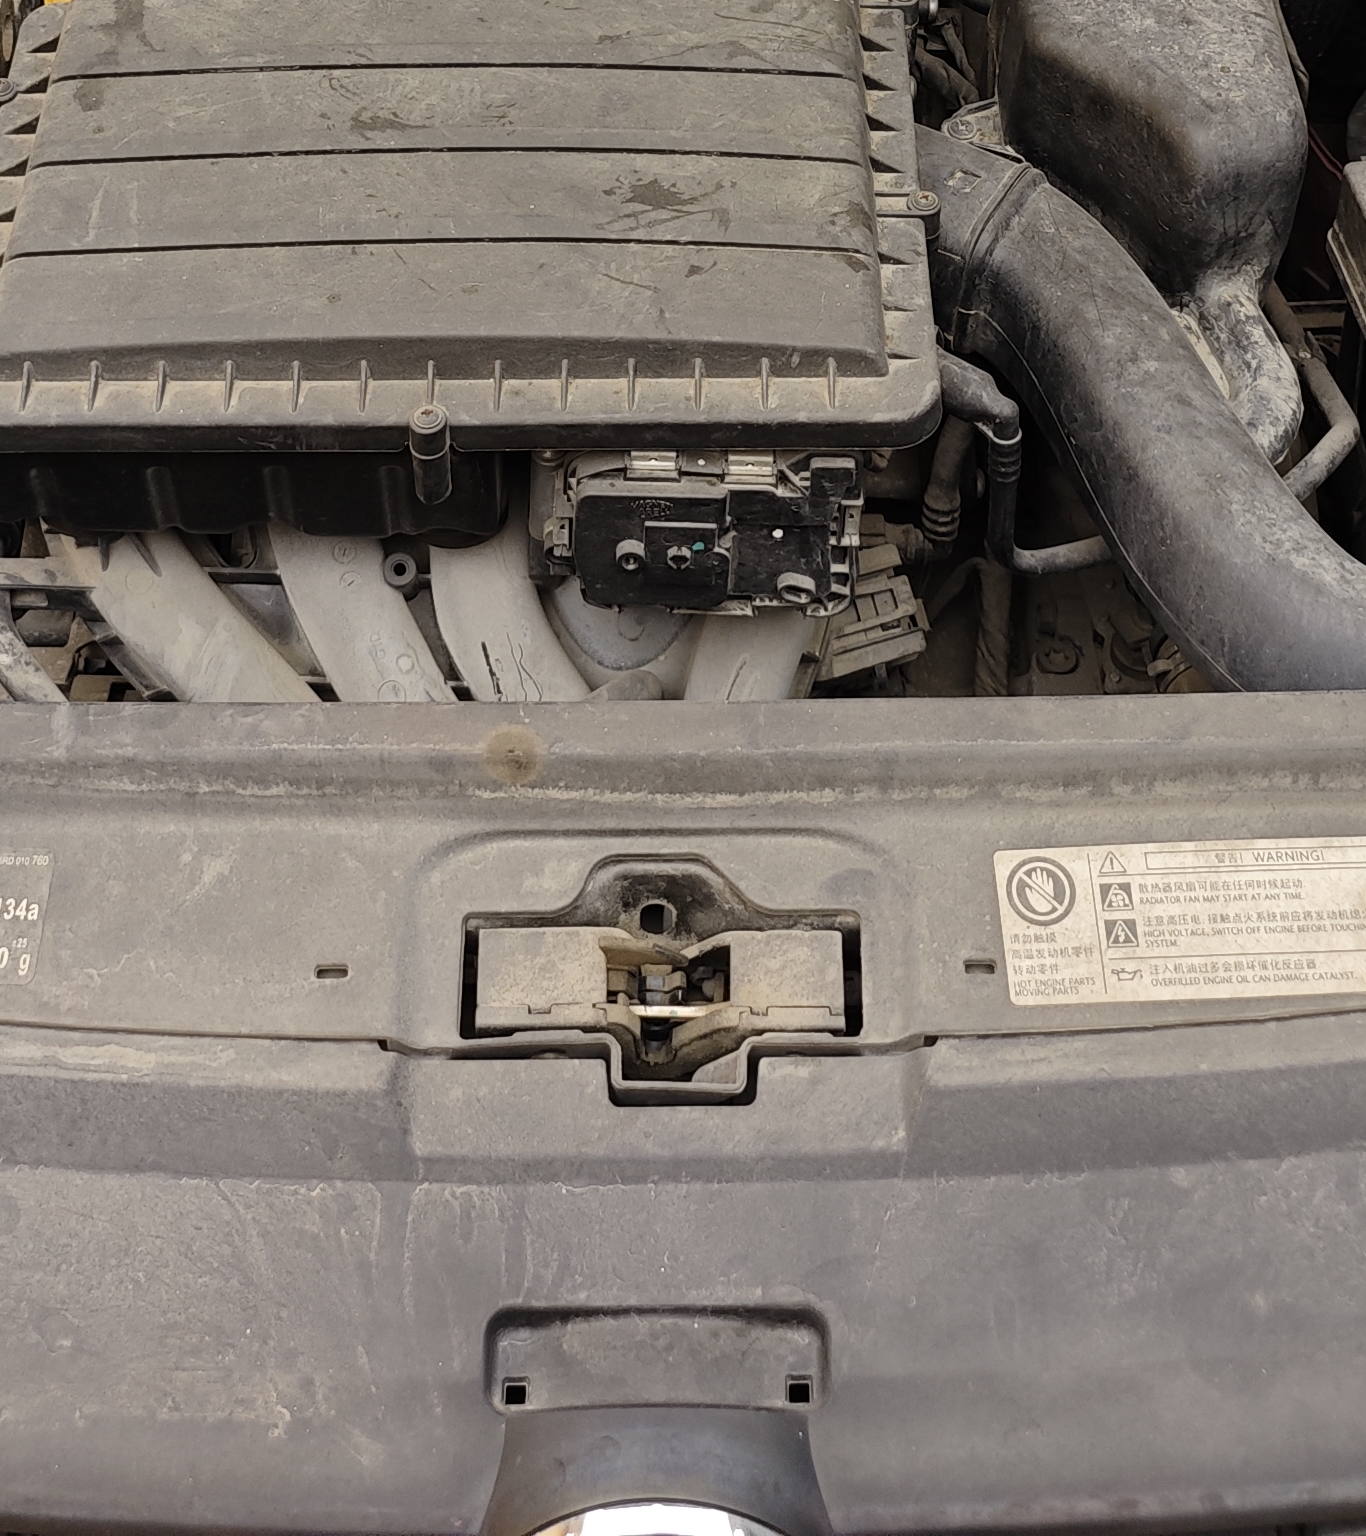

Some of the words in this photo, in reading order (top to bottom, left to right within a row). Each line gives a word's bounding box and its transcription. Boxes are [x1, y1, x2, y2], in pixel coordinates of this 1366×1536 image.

[16, 857, 29, 865] 010
[32, 855, 49, 865] 760
[1252, 849, 1325, 863] WARNING!
[1139, 895, 1181, 905] RADIATOR
[1185, 895, 1200, 904] FAN
[1202, 894, 1220, 903] MAY
[1223, 893, 1248, 902] START
[1250, 893, 1262, 901] AT
[1264, 892, 1281, 901] ANY
[1143, 929, 1165, 938] HIGH
[1212, 926, 1243, 936] SWITCH
[1245, 925, 1261, 935] OFF
[1264, 924, 1295, 934] ENGINE
[1297, 922, 1328, 933] BEFORE
[1010, 932, 1057, 944] 请勿触摸
[1012, 946, 1094, 960] 高温发动机零件
[17, 951, 31, 976] g
[1013, 962, 1060, 976] 转动零件
[1014, 980, 1032, 989] HOT
[1036, 978, 1066, 987] ENGINE
[1069, 977, 1095, 986] PARTS
[1151, 976, 1200, 987] OVERFILLED
[1203, 975, 1234, 985] ENGINE
[1236, 974, 1250, 984] OIL
[1253, 973, 1271, 983] CAN
[1273, 972, 1310, 982] DAMAGE
[1312, 971, 1358, 982] CATALYST.
[1015, 987, 1050, 996] MOVING
[1052, 986, 1079, 995] PARTS
